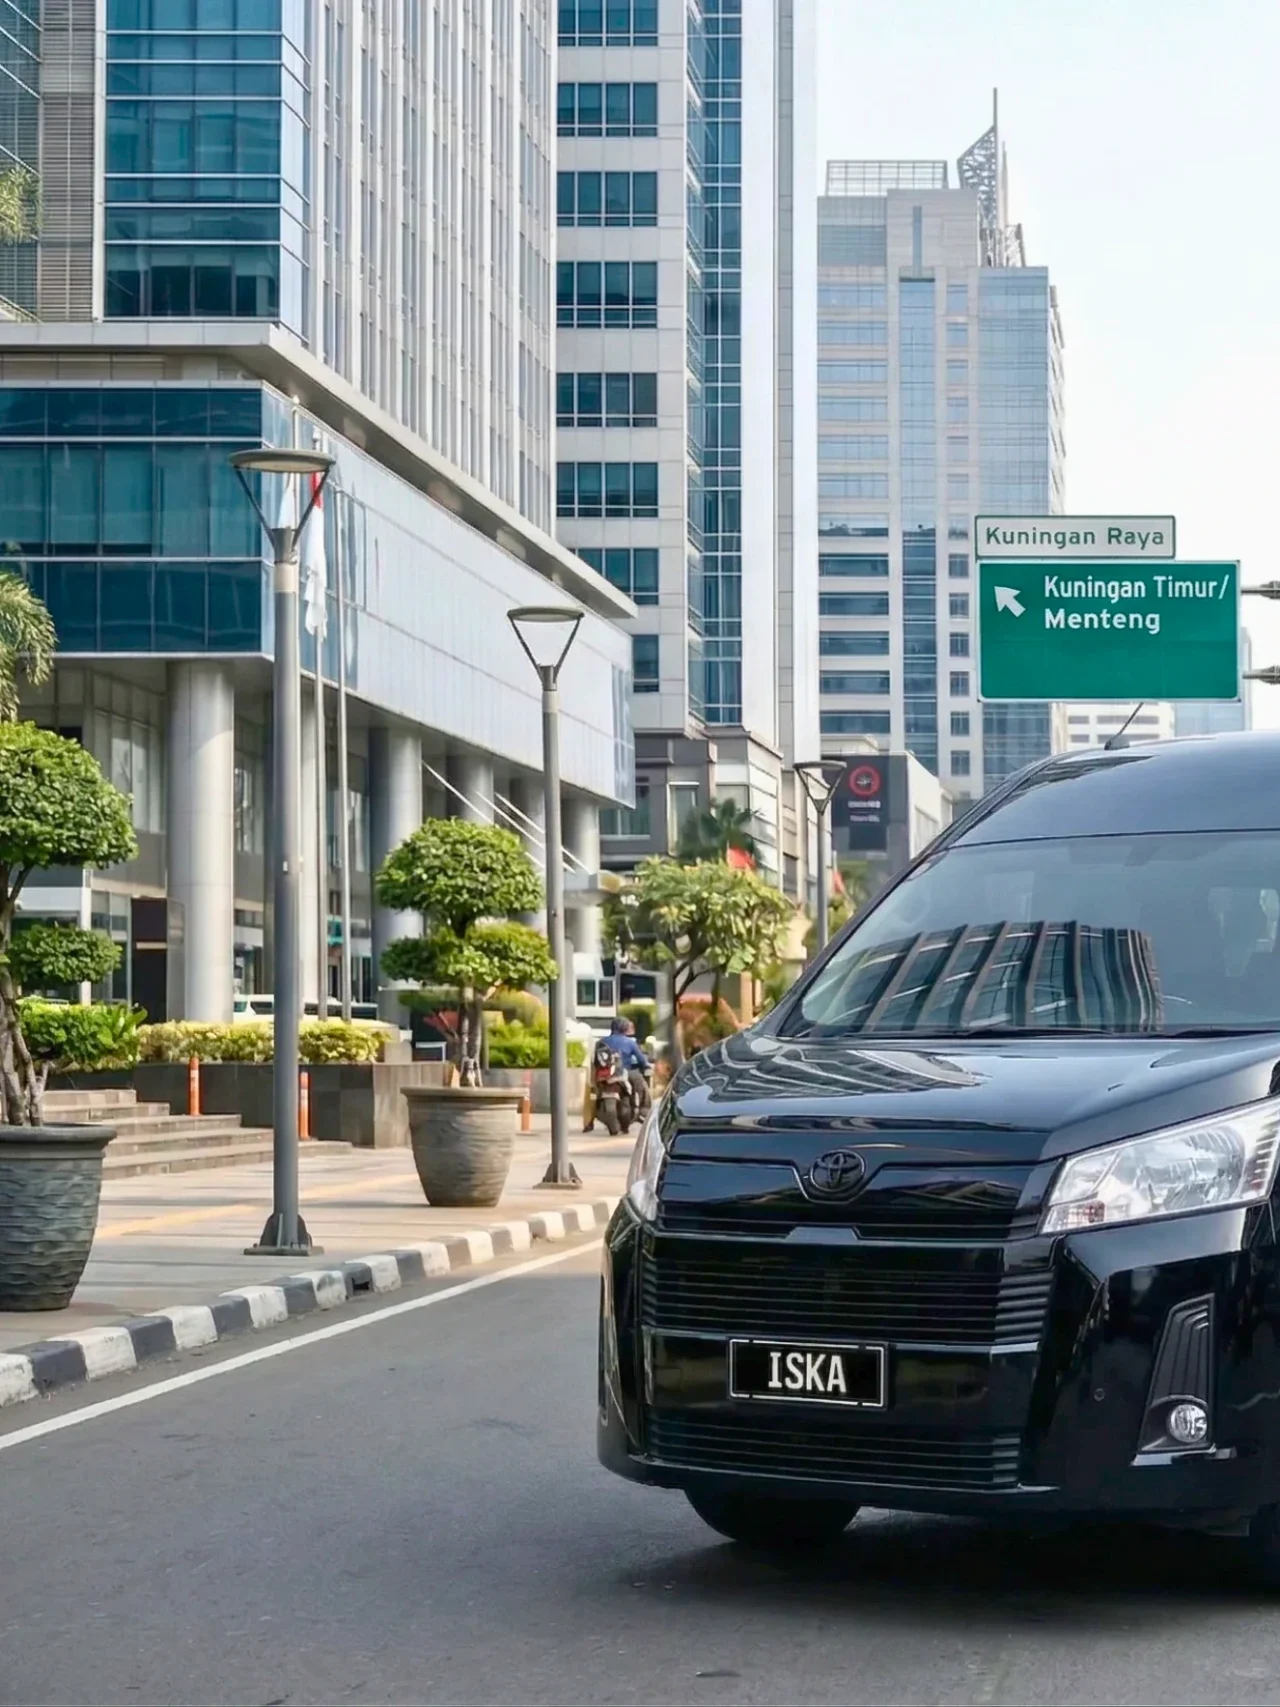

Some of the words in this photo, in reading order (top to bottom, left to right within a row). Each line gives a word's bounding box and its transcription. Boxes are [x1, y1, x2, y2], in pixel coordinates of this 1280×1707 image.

[987, 526, 1096, 550] Kuningan
[1107, 526, 1164, 551] Raya
[1044, 575, 1146, 603] Kuningan
[1153, 574, 1230, 599] Timur/
[1044, 608, 1160, 635] Menteng
[768, 1351, 847, 1394] ISKA
